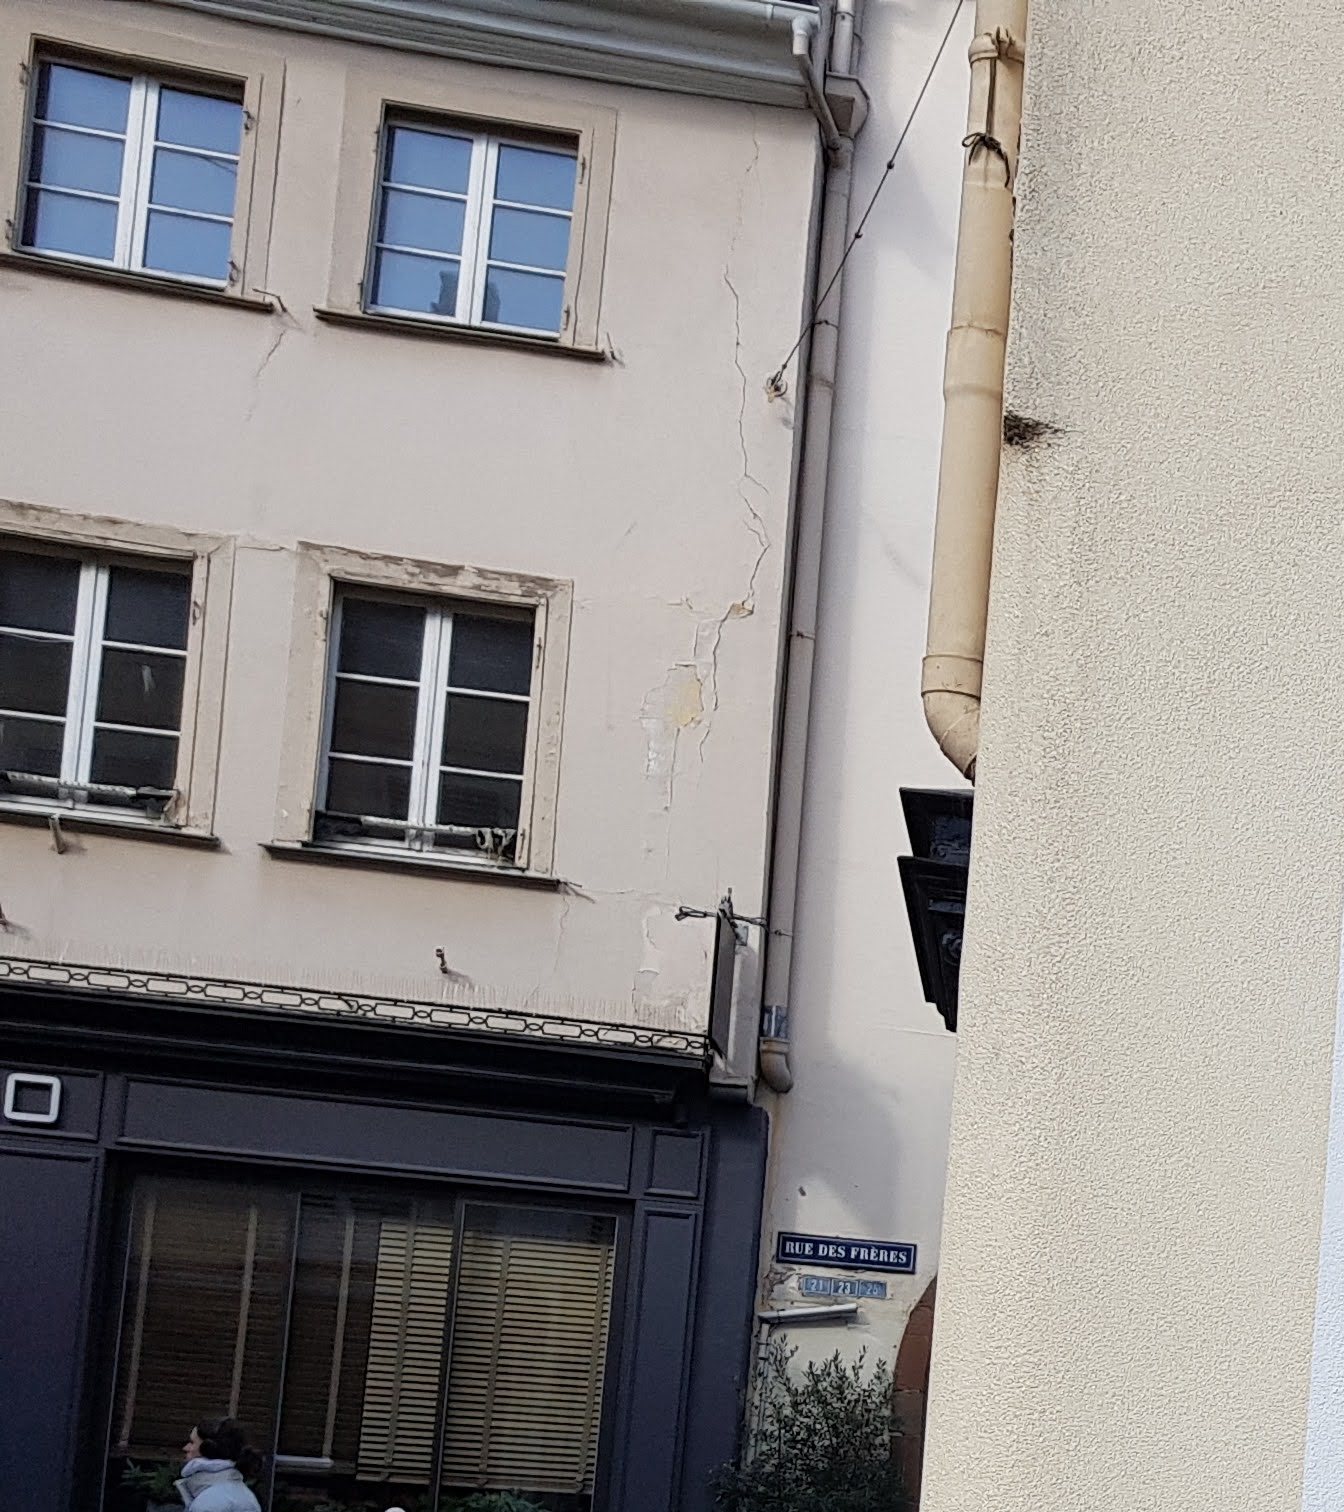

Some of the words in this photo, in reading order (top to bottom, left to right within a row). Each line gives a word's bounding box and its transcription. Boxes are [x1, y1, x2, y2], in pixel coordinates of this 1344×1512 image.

[784, 1240, 813, 1256] RUE
[817, 1244, 846, 1259] DES
[850, 1245, 907, 1264] FRÈRES
[810, 1278, 824, 1292] 21
[838, 1281, 852, 1295] 23
